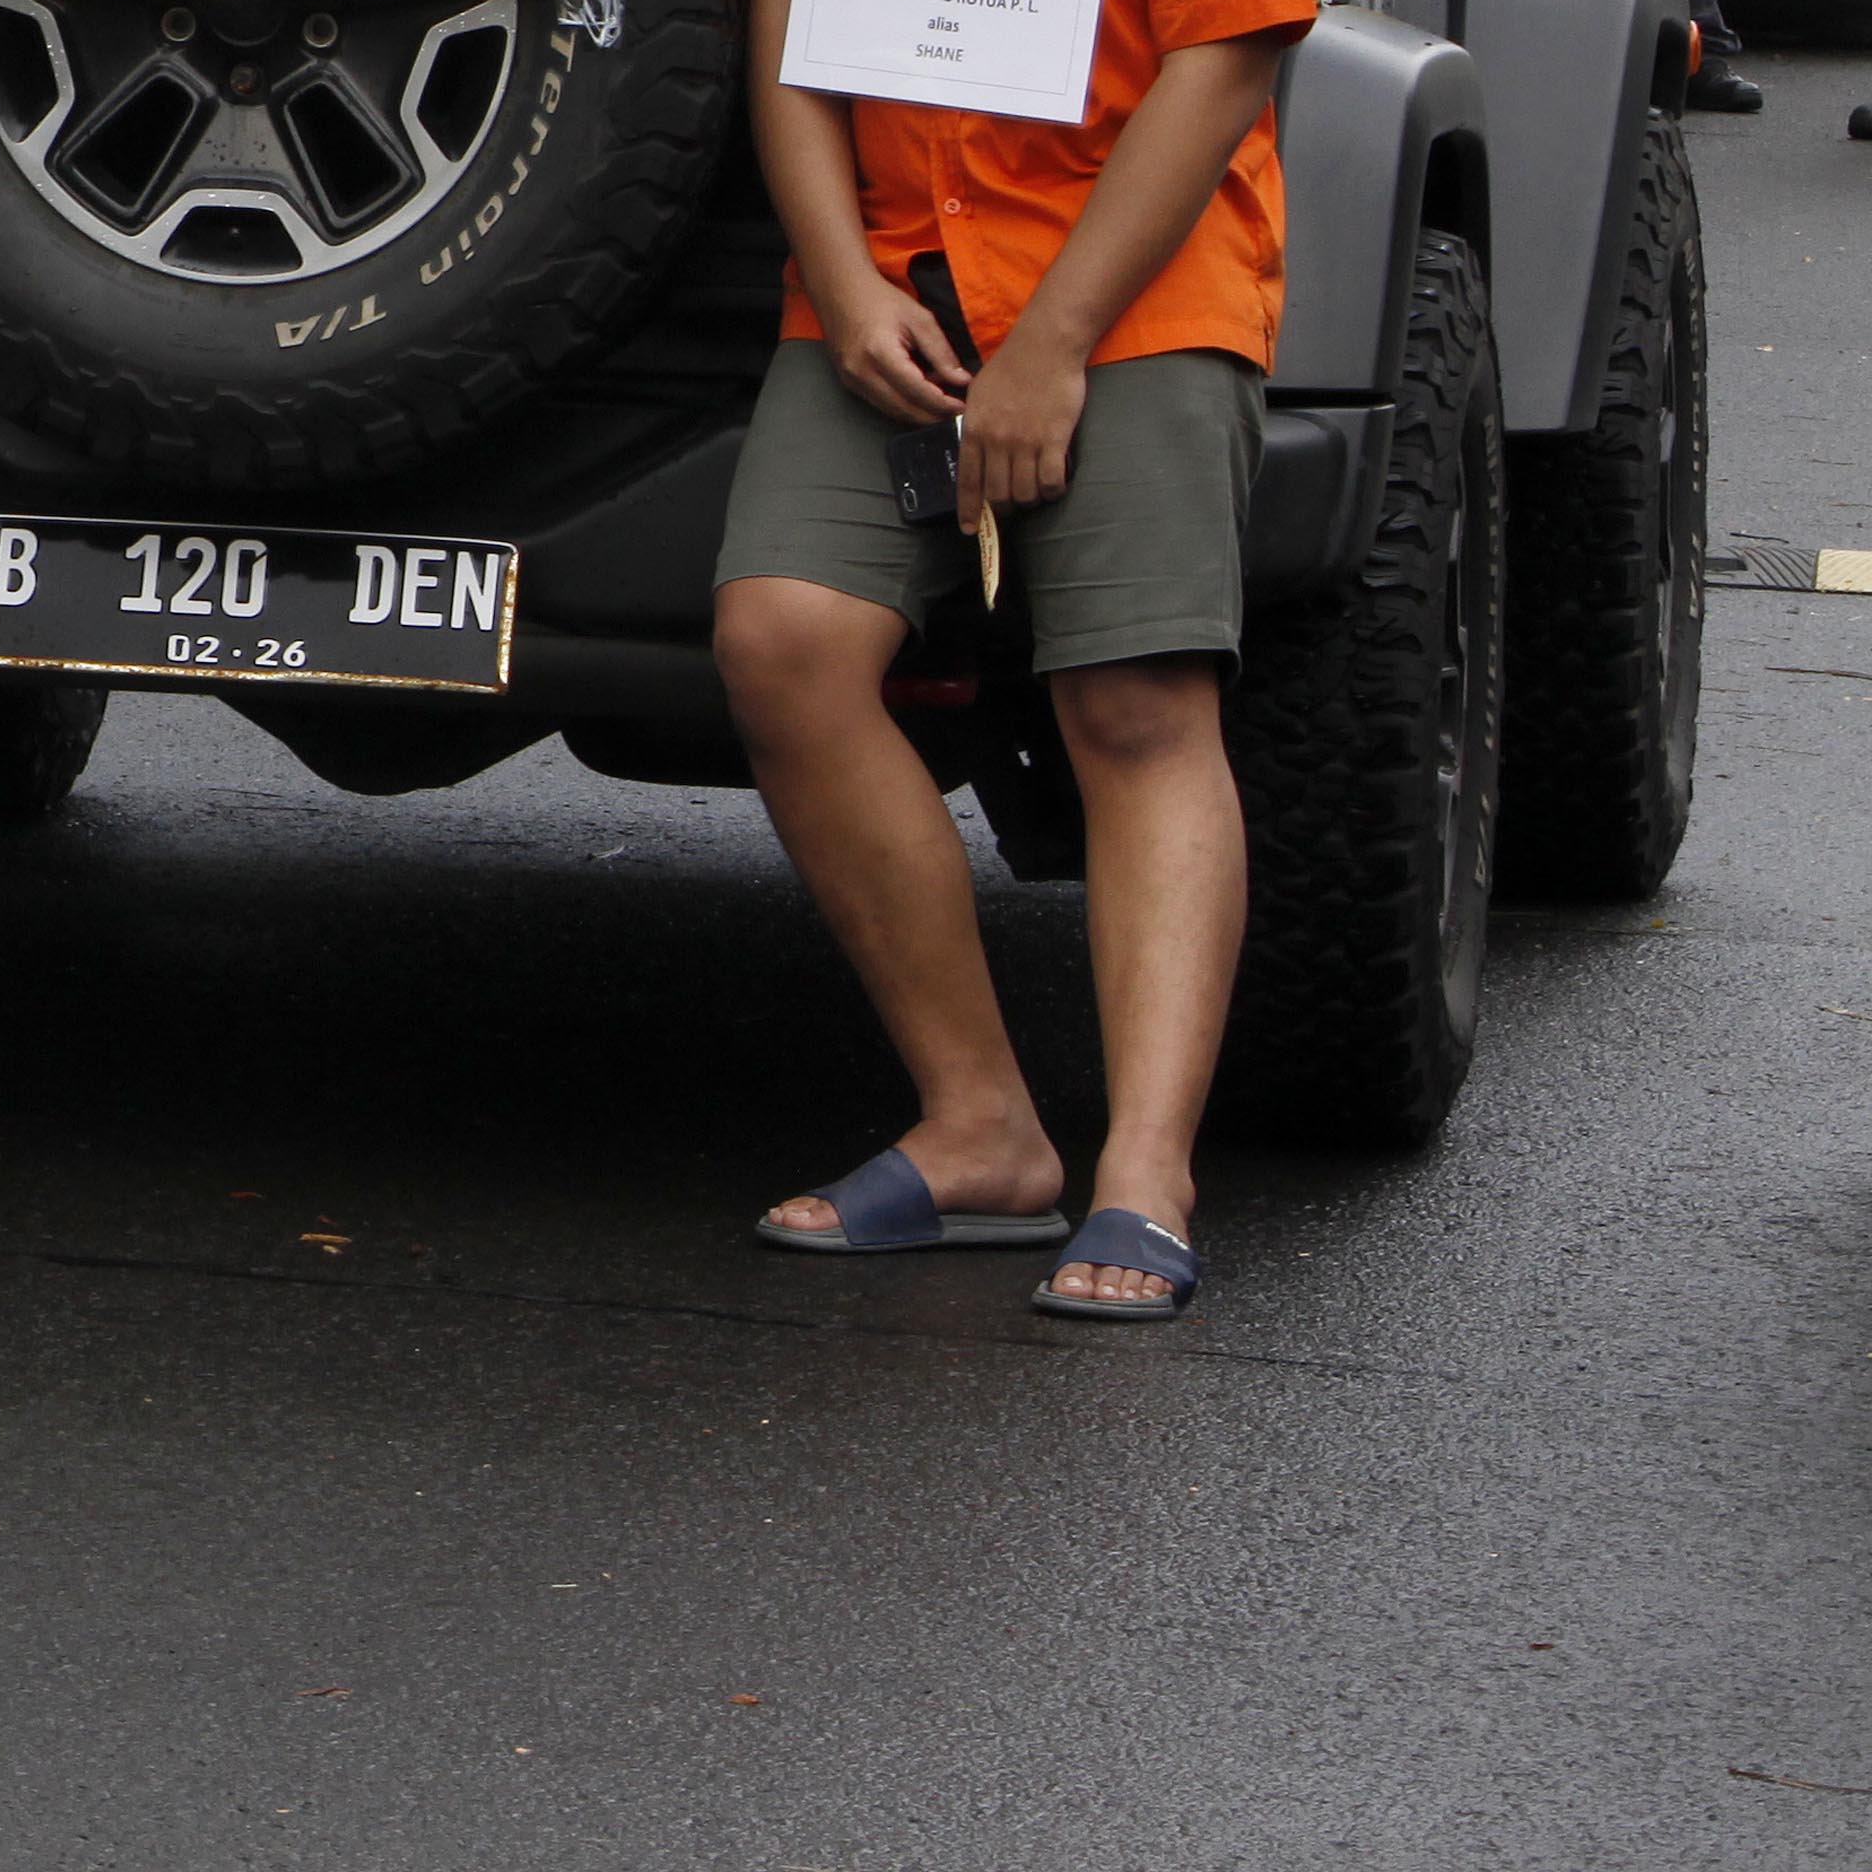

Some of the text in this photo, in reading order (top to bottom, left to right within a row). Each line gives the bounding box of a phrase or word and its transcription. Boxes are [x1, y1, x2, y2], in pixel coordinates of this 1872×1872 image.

[1028, 0, 1039, 14] L.
[927, 16, 960, 33] alias
[914, 43, 965, 63] SHANE
[274, 293, 387, 349] T/A
[119, 534, 269, 618] 120
[348, 545, 500, 631] DEN
